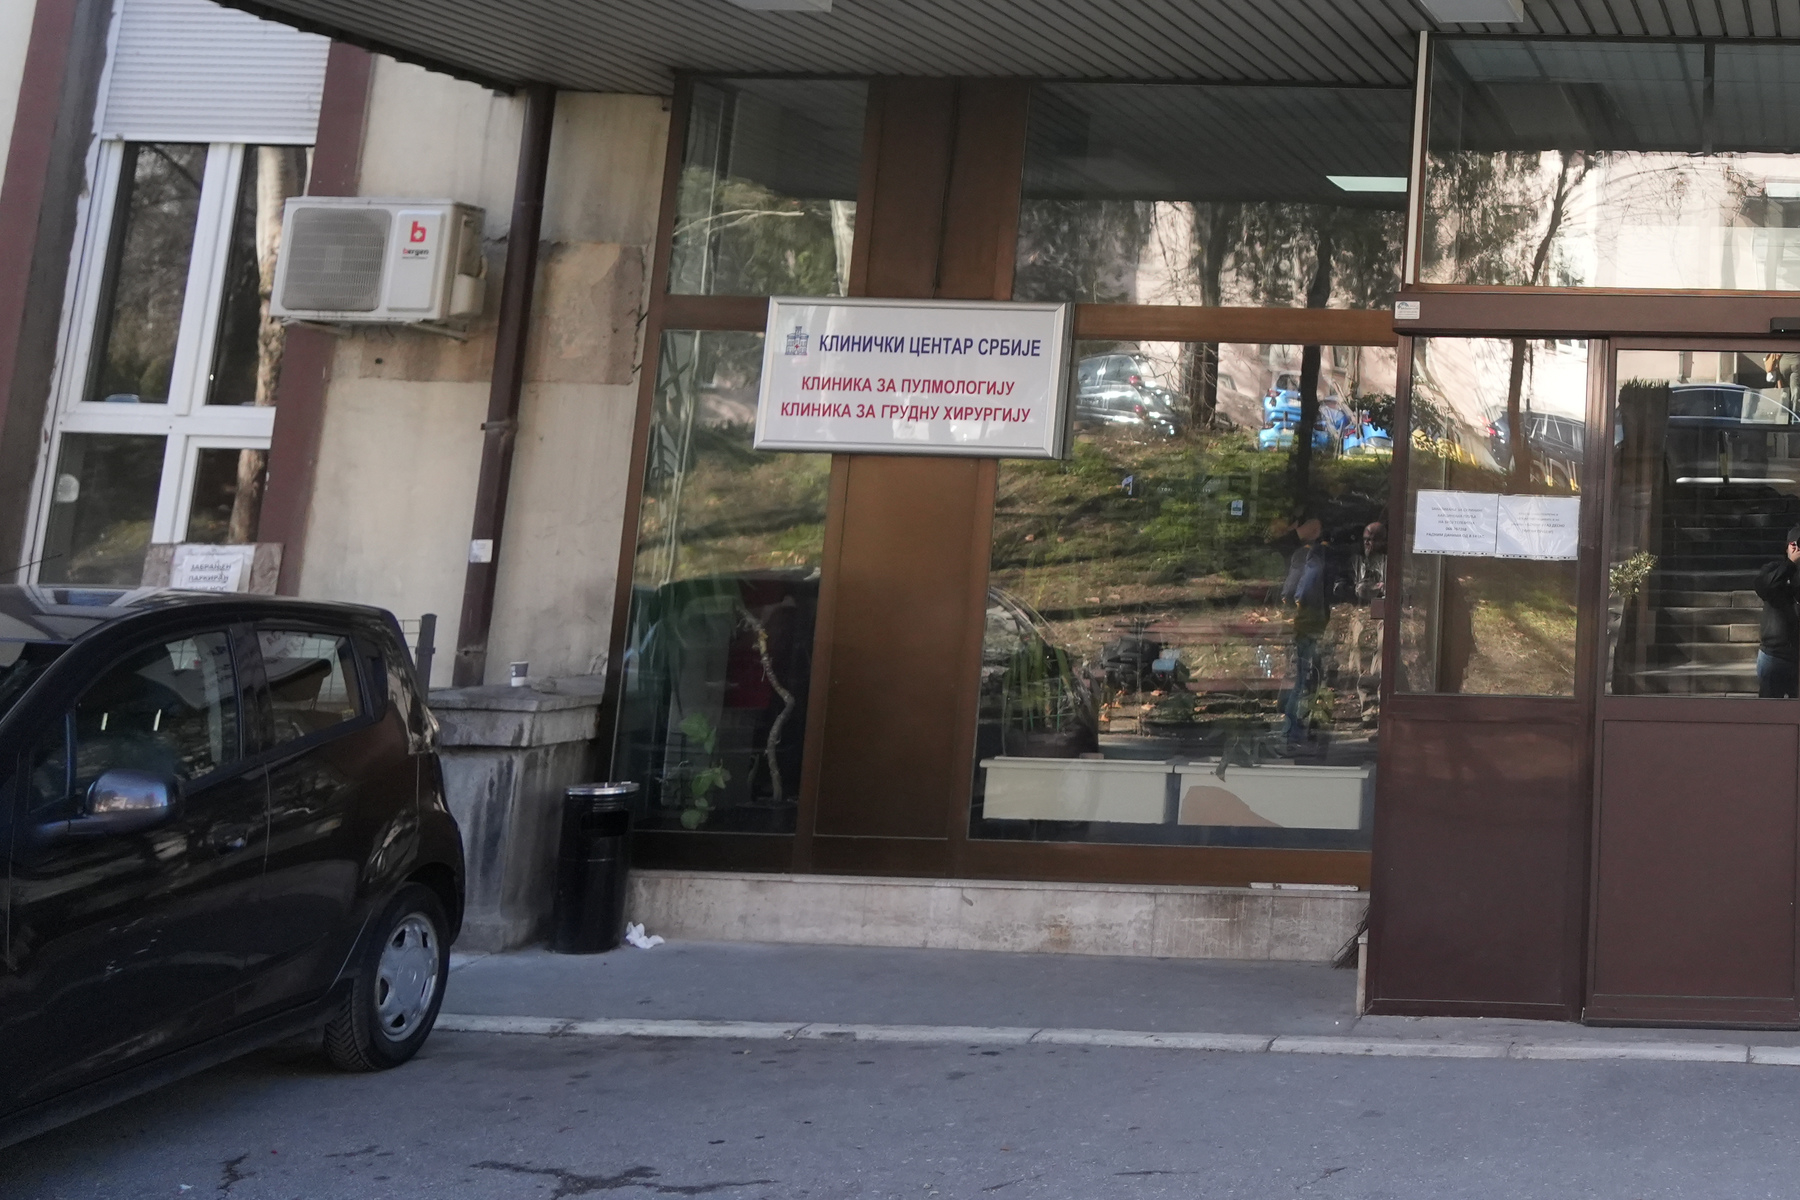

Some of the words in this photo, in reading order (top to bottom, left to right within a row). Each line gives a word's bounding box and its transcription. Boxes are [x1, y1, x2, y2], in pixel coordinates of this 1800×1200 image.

[403, 248, 430, 256] bergen
[819, 334, 905, 353] КЛИНИЧКИ
[909, 336, 974, 357] ЦЕНТАР
[977, 338, 1041, 357] СРБИЈЕ
[801, 376, 872, 392] КЛИНИКА
[876, 378, 896, 393] ЗА
[901, 378, 1015, 396] ПУЛМОЛОГИЈУ
[780, 402, 851, 418] КЛИНИКА
[855, 403, 876, 419] ЗА
[880, 404, 940, 422] ГРУДНУ
[942, 405, 1031, 423] ХИРУРГИЈУ
